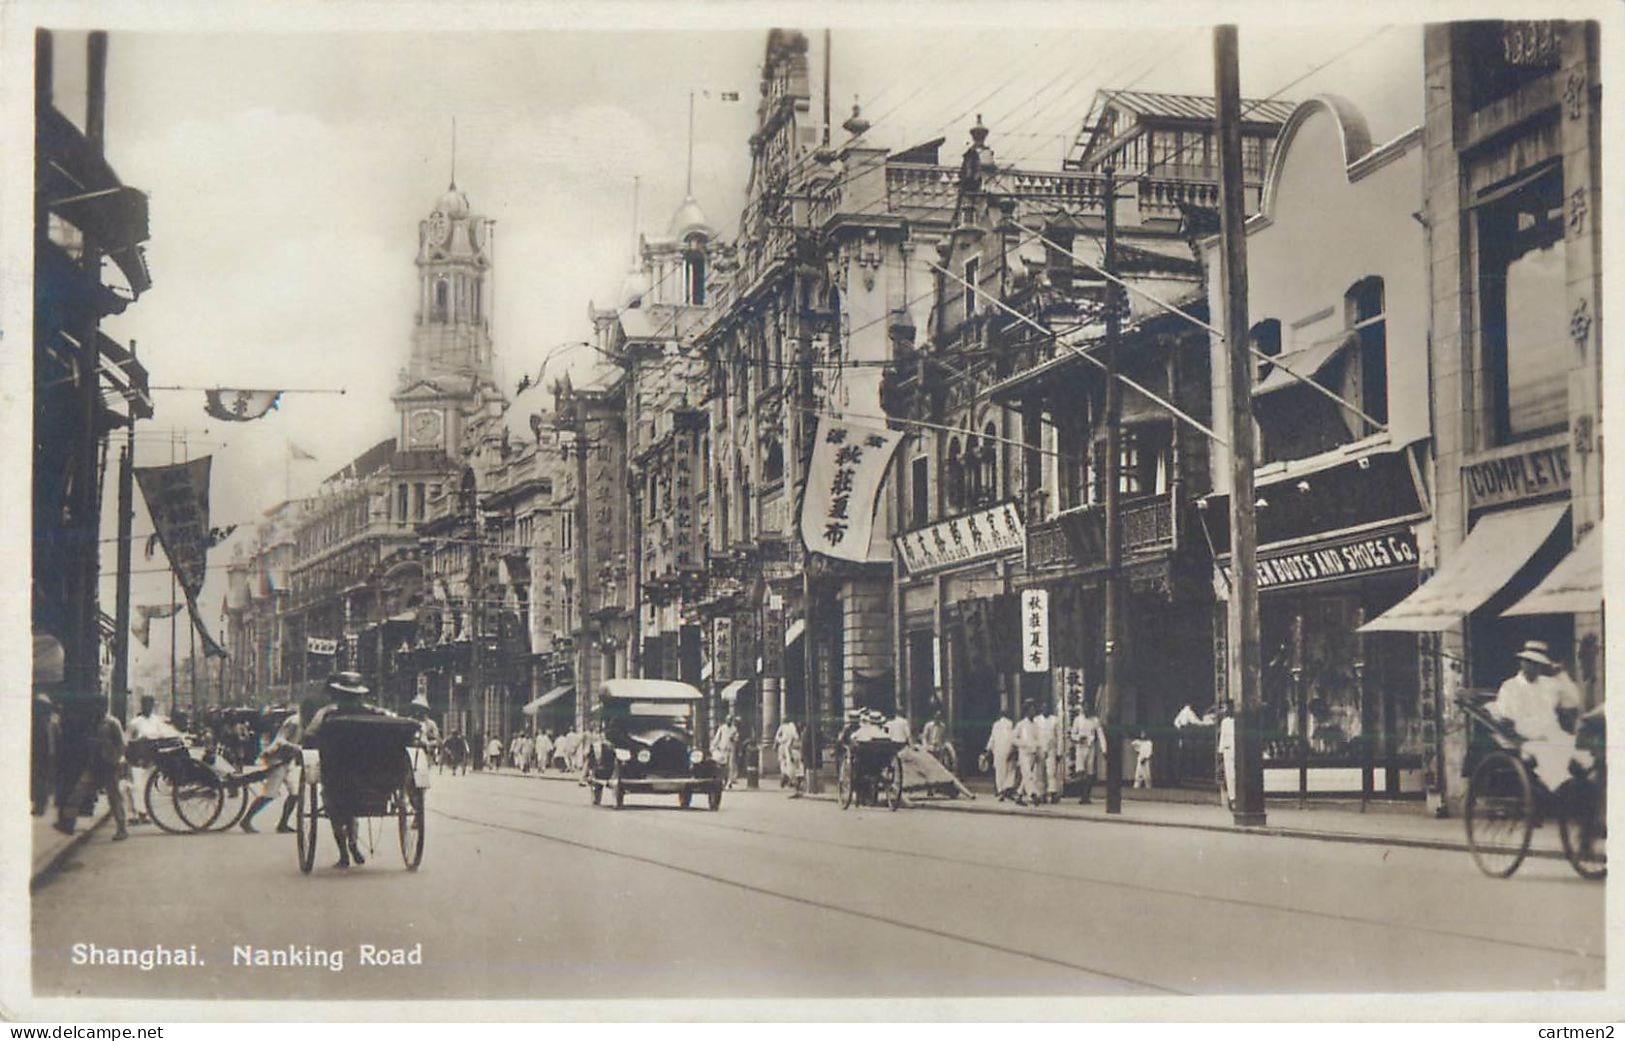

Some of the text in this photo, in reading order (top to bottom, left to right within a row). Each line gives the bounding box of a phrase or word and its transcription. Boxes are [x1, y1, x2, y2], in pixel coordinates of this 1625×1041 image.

[1470, 447, 1571, 497] COMPLETE
[1272, 553, 1318, 583] BOOTS
[1314, 547, 1345, 576] AND
[1342, 540, 1391, 571] SHOES
[1388, 536, 1417, 563] Co.
[1027, 596, 1044, 668] 秋莊夏布
